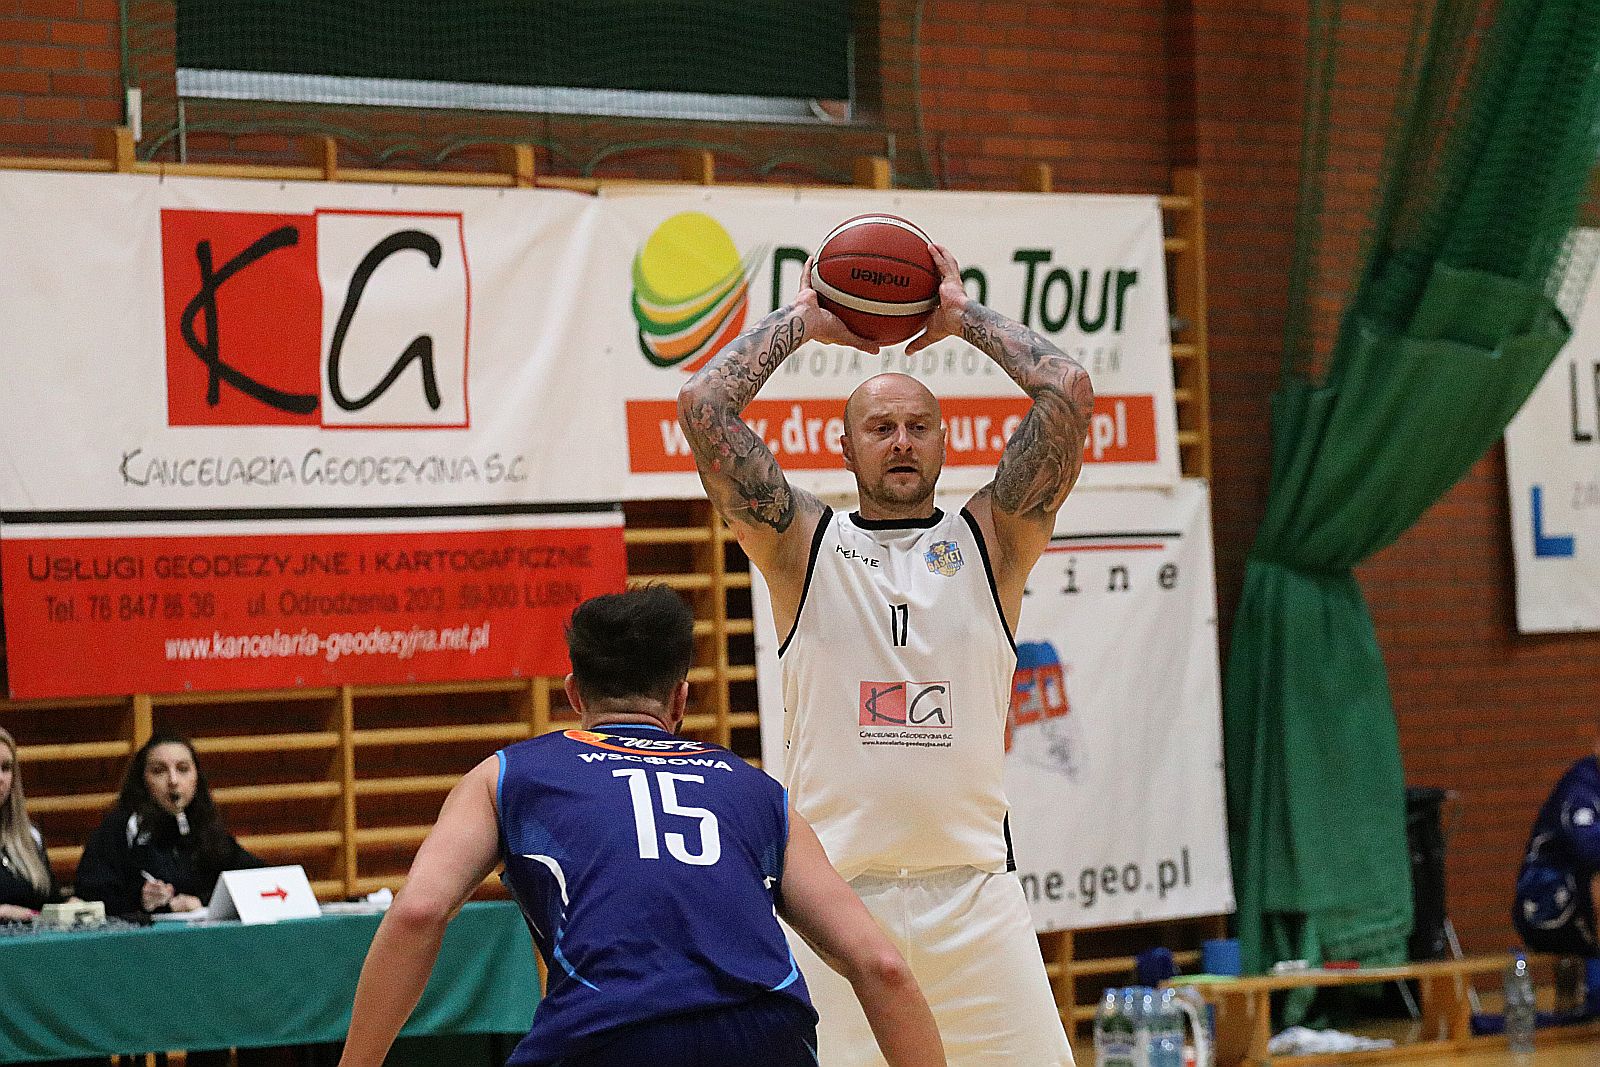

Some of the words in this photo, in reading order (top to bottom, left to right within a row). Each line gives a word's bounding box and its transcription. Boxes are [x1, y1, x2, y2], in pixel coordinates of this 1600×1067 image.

[851, 267, 911, 288] molten
[1012, 249, 1138, 334] Tour
[888, 603, 909, 647] 17
[611, 768, 721, 866] 15
